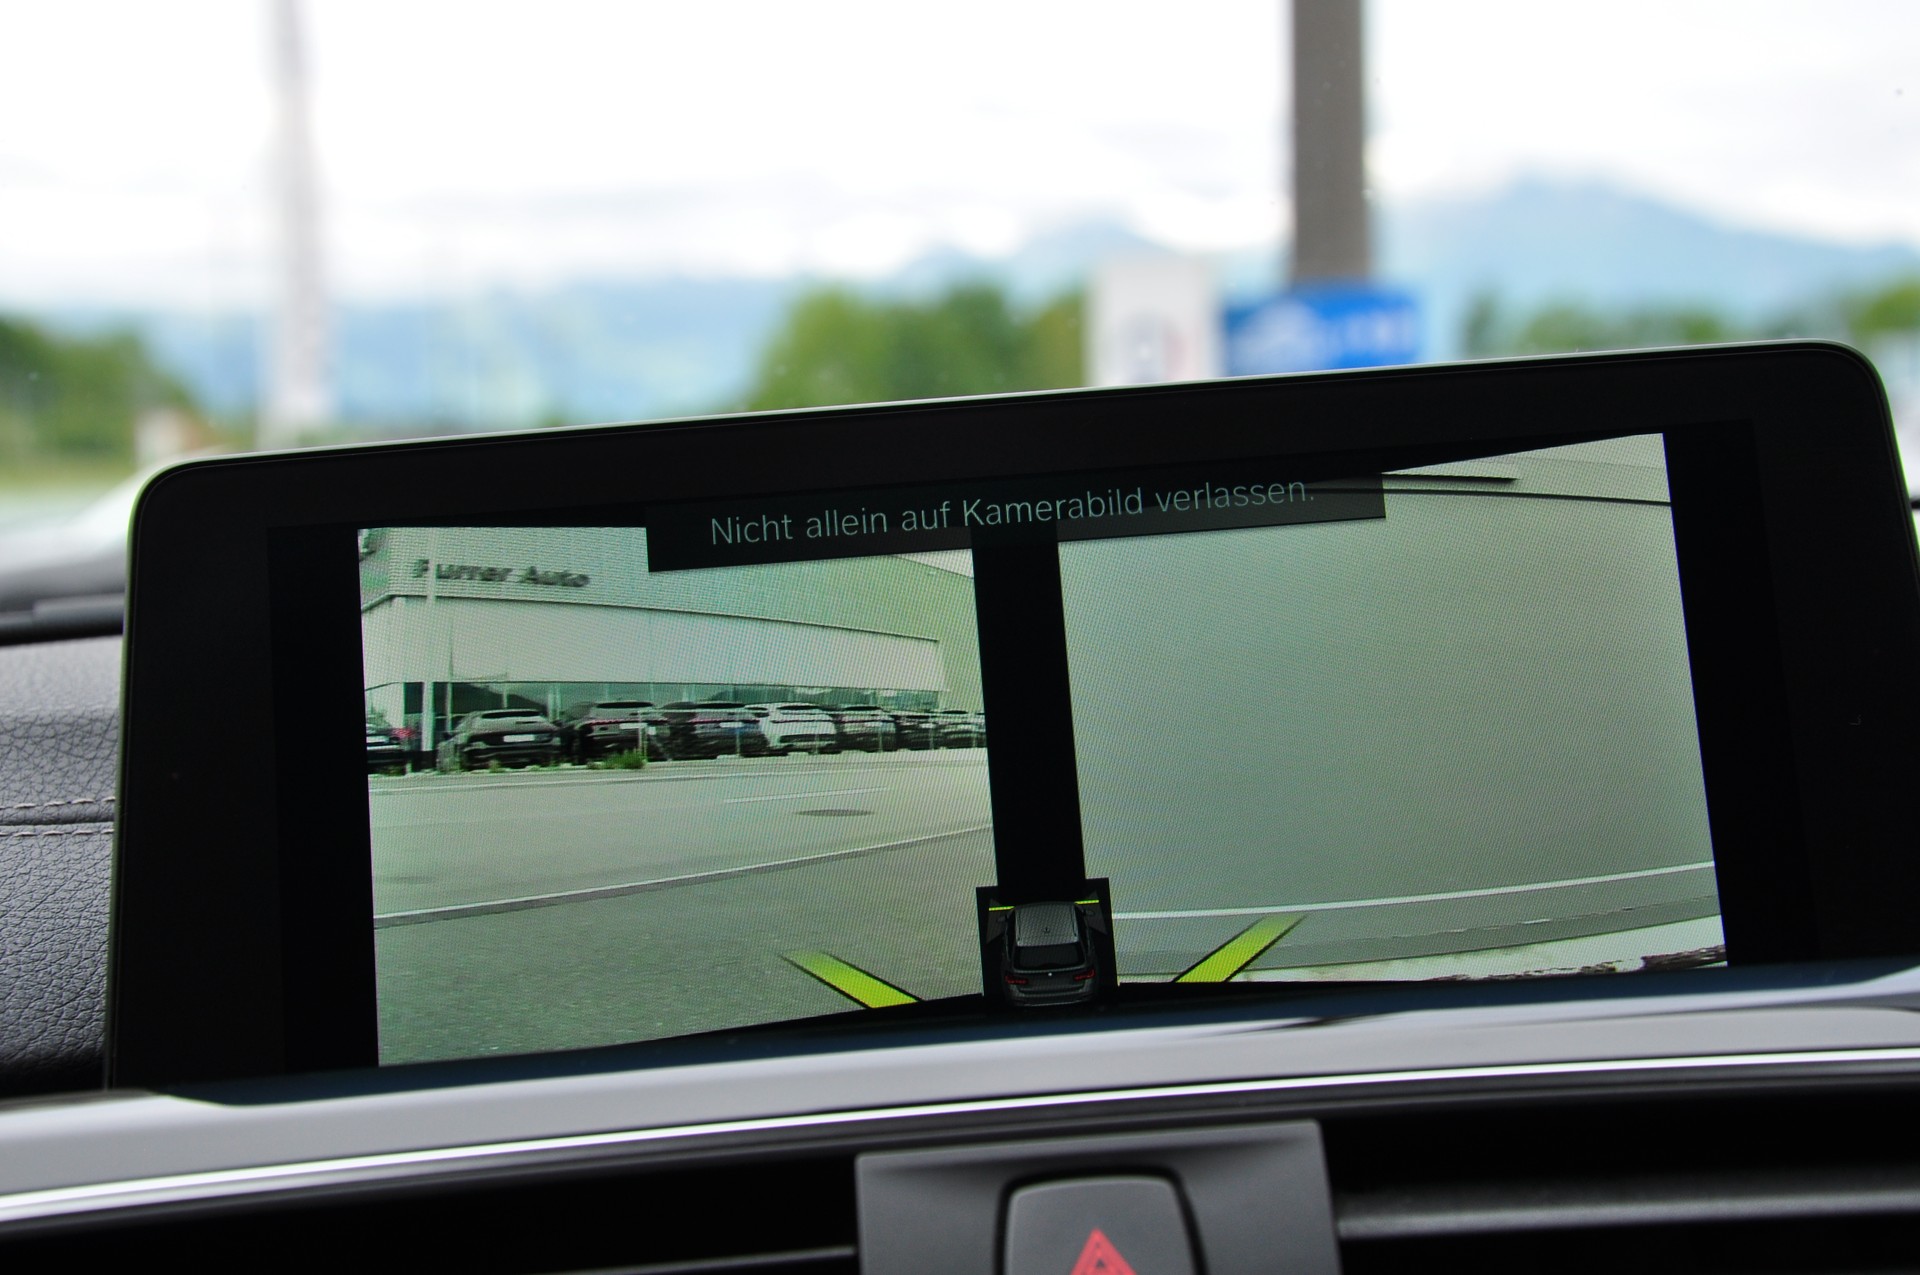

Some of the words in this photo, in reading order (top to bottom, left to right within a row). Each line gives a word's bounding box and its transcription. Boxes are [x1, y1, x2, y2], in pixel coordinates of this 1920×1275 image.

[710, 513, 794, 546] Nicht
[805, 506, 889, 539] allein
[900, 500, 952, 532] auf
[961, 487, 1143, 527] Kamerabild
[1156, 480, 1314, 513] verlassen.
